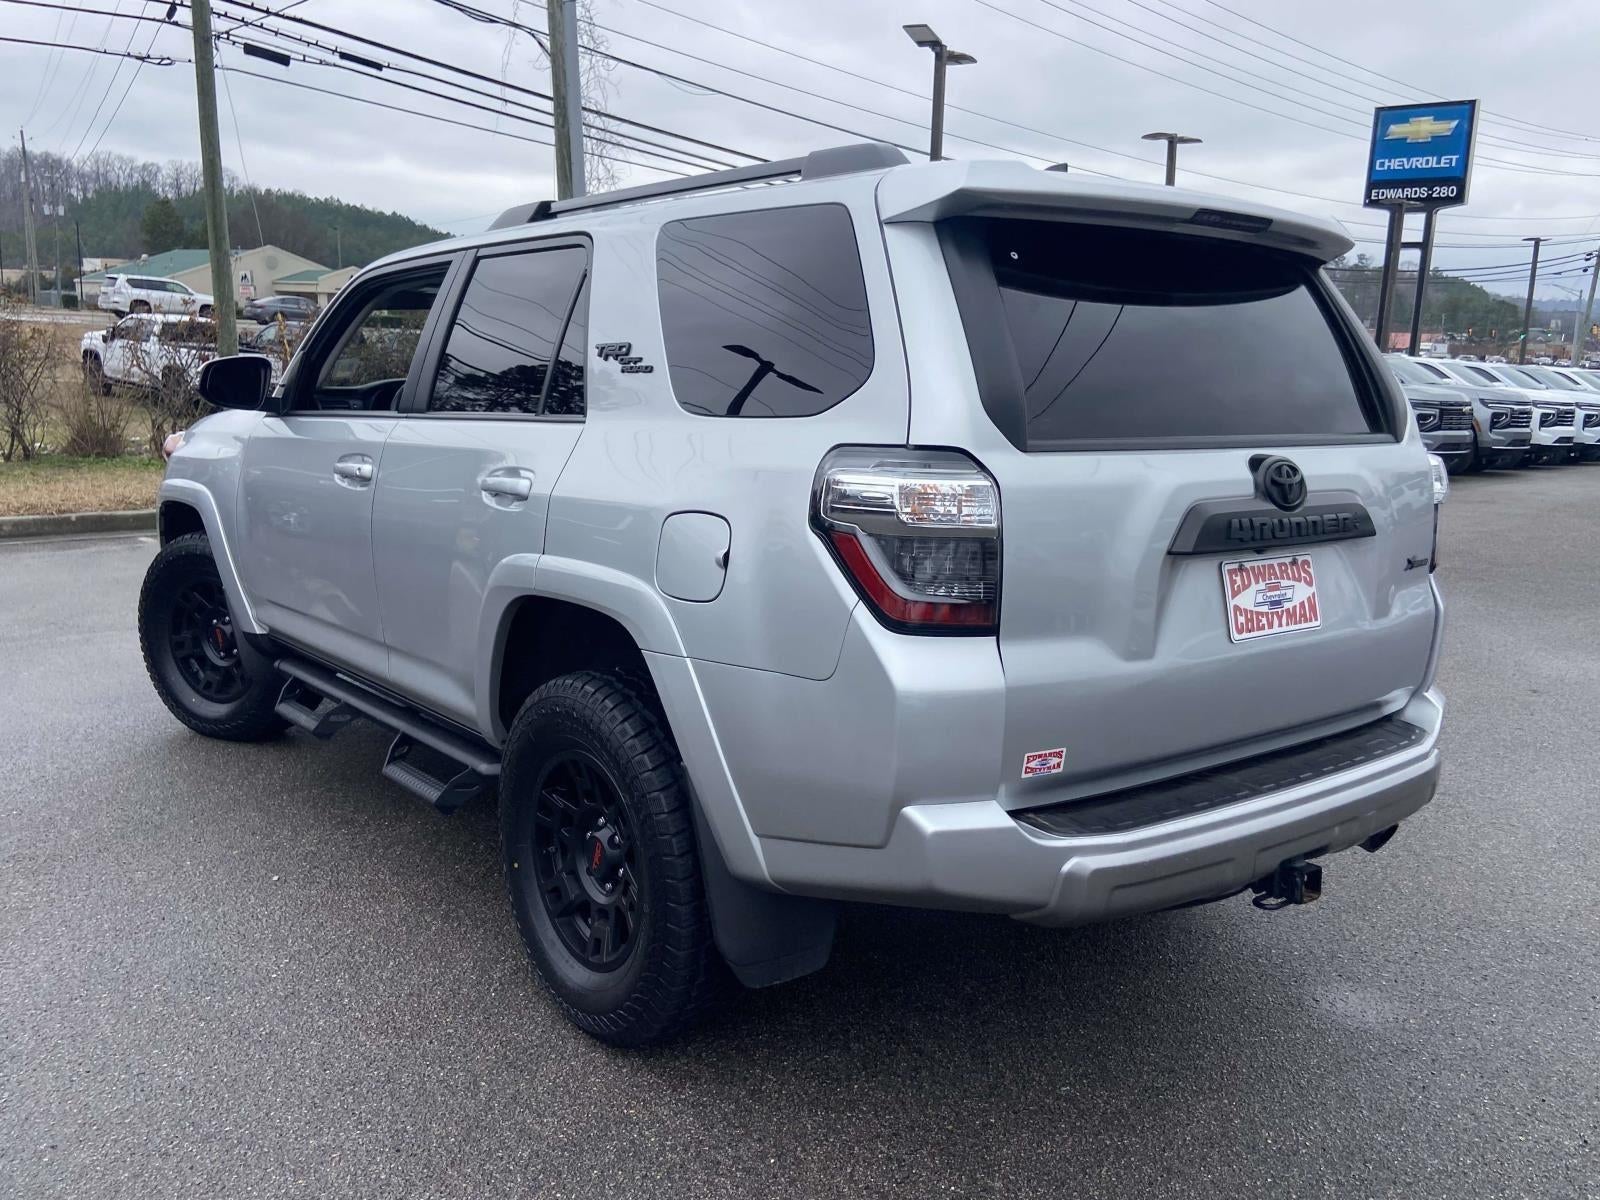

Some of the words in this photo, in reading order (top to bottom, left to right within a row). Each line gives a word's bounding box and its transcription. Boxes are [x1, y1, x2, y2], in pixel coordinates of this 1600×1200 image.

[1376, 155, 1460, 170] CHEVROLET
[1371, 186, 1457, 200] EDWARDS-280
[595, 342, 631, 361] TRD
[619, 357, 643, 365] OFF
[621, 365, 654, 373] ROAD
[1230, 512, 1359, 541] 4RUNNER
[1227, 559, 1314, 600] EDWARDS
[1262, 591, 1287, 601] Chevrolet
[1232, 592, 1319, 635] CHEVYMAN
[1026, 750, 1064, 765] EDWARDS
[1024, 760, 1062, 775] CHEVYMAN
